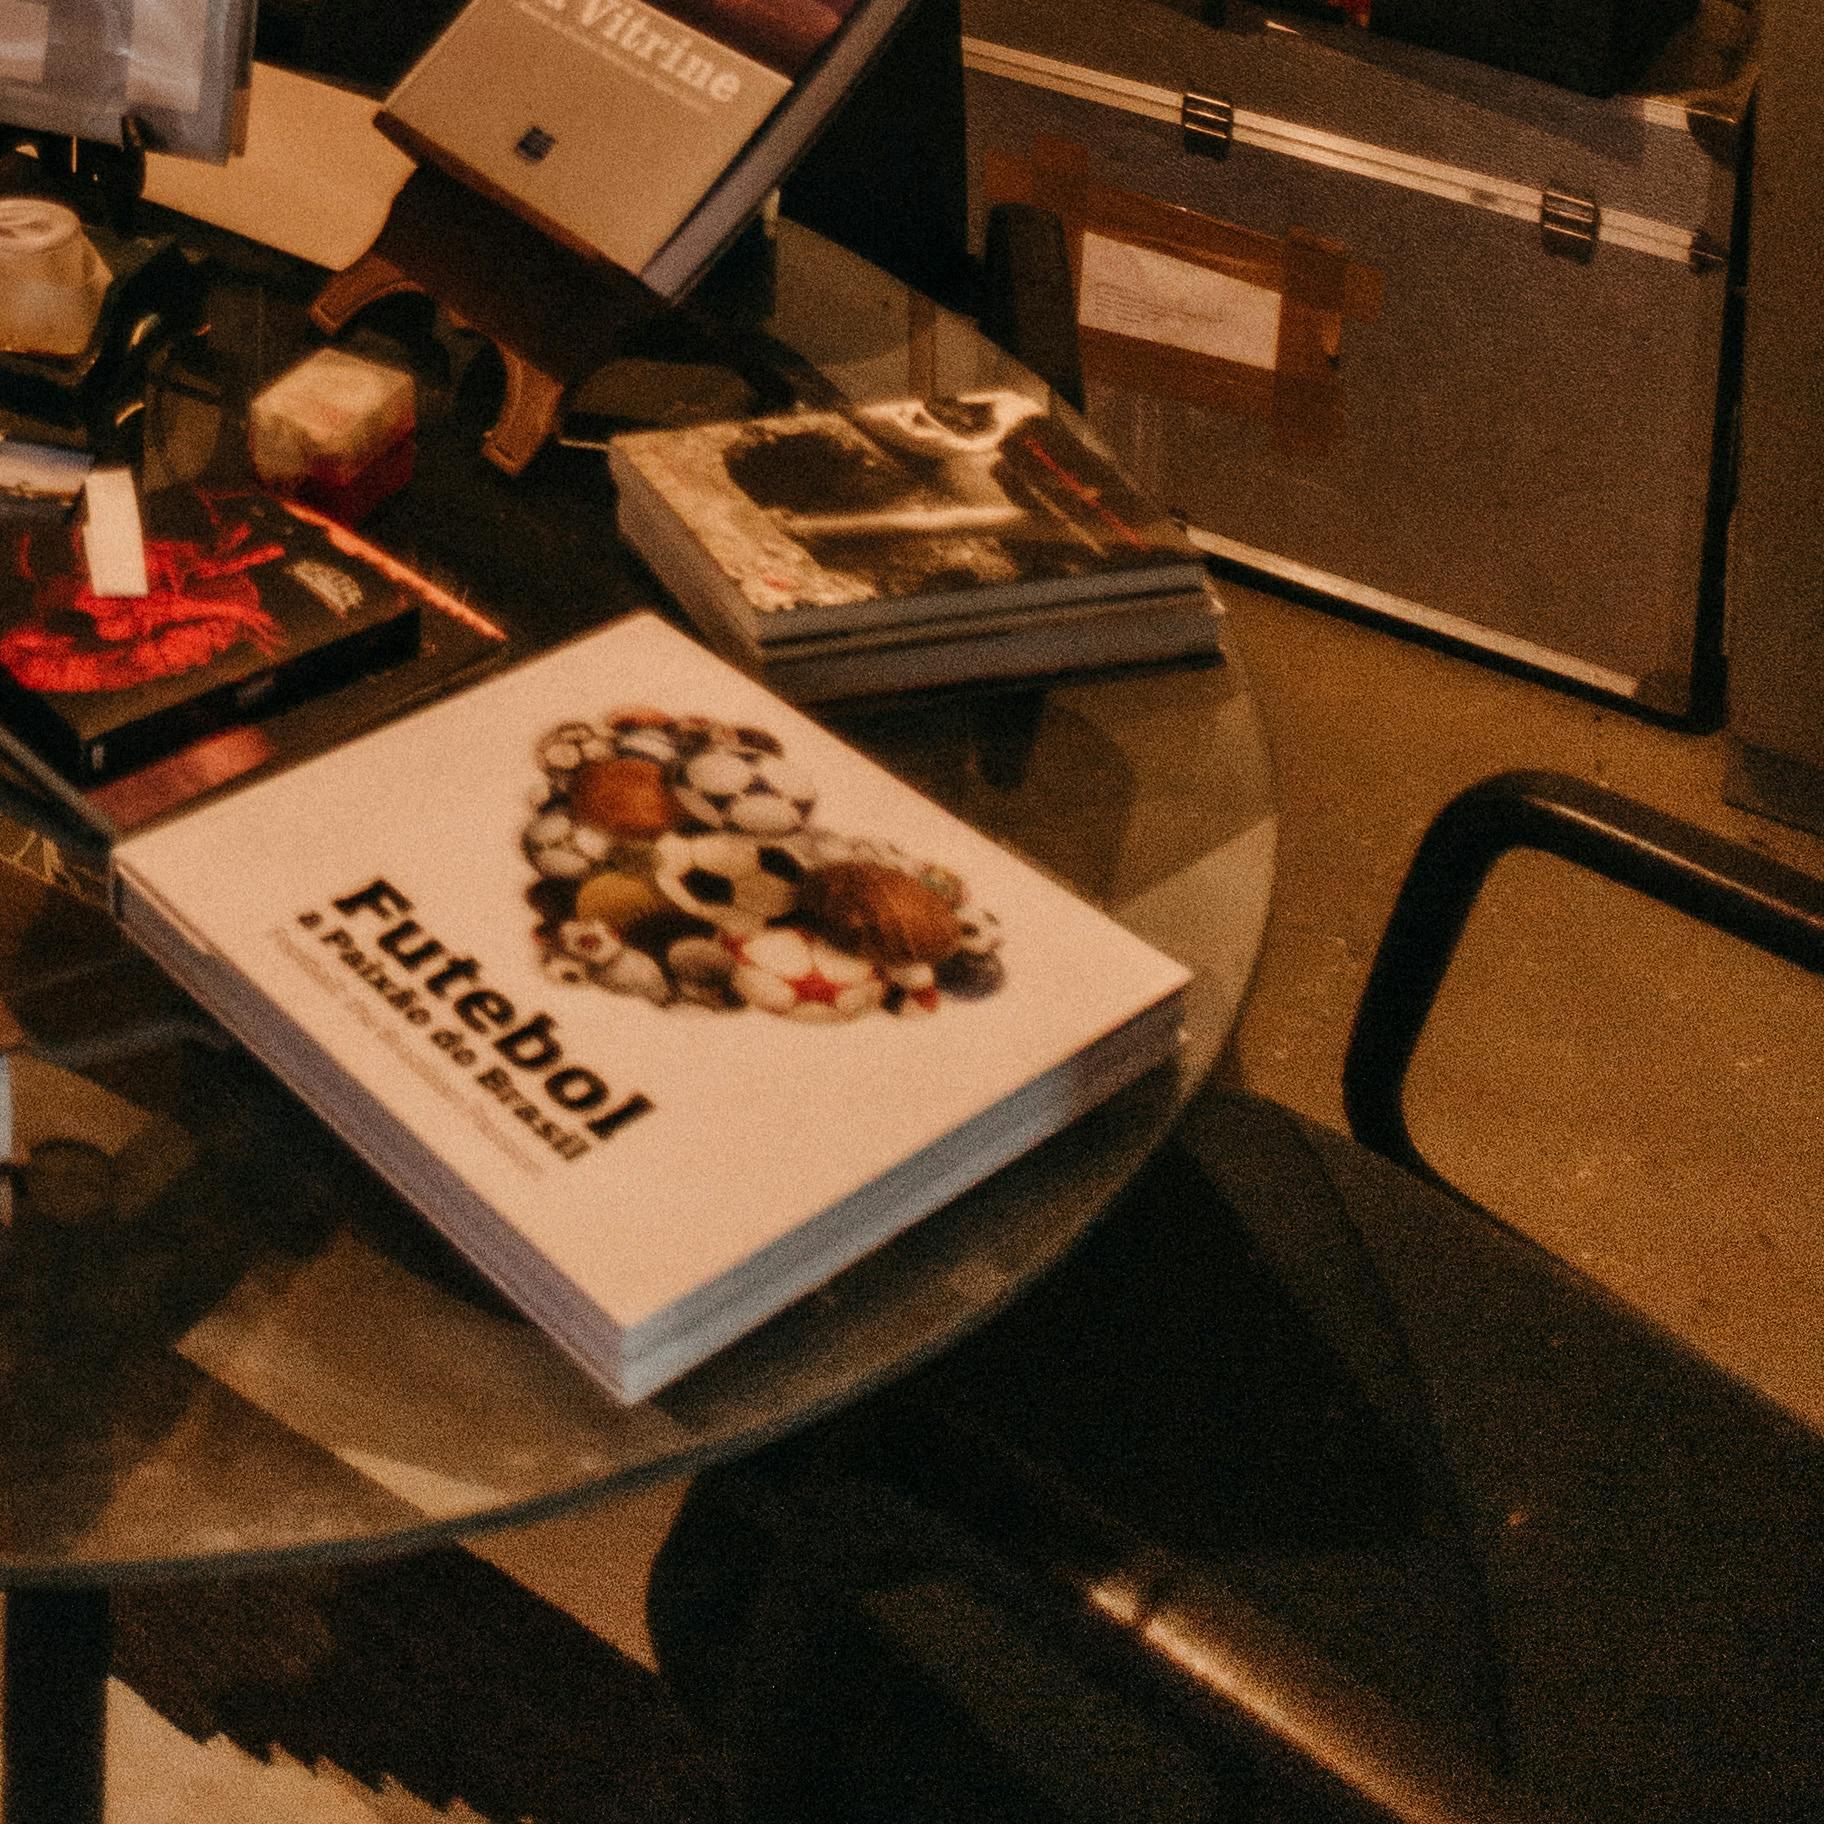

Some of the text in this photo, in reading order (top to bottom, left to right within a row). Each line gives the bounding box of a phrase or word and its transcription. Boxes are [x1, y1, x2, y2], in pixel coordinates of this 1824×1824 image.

[319, 928, 434, 1027] Paixão
[429, 1027, 476, 1067] do
[475, 1064, 592, 1163] Brasil
[331, 875, 657, 1142] Futebol
